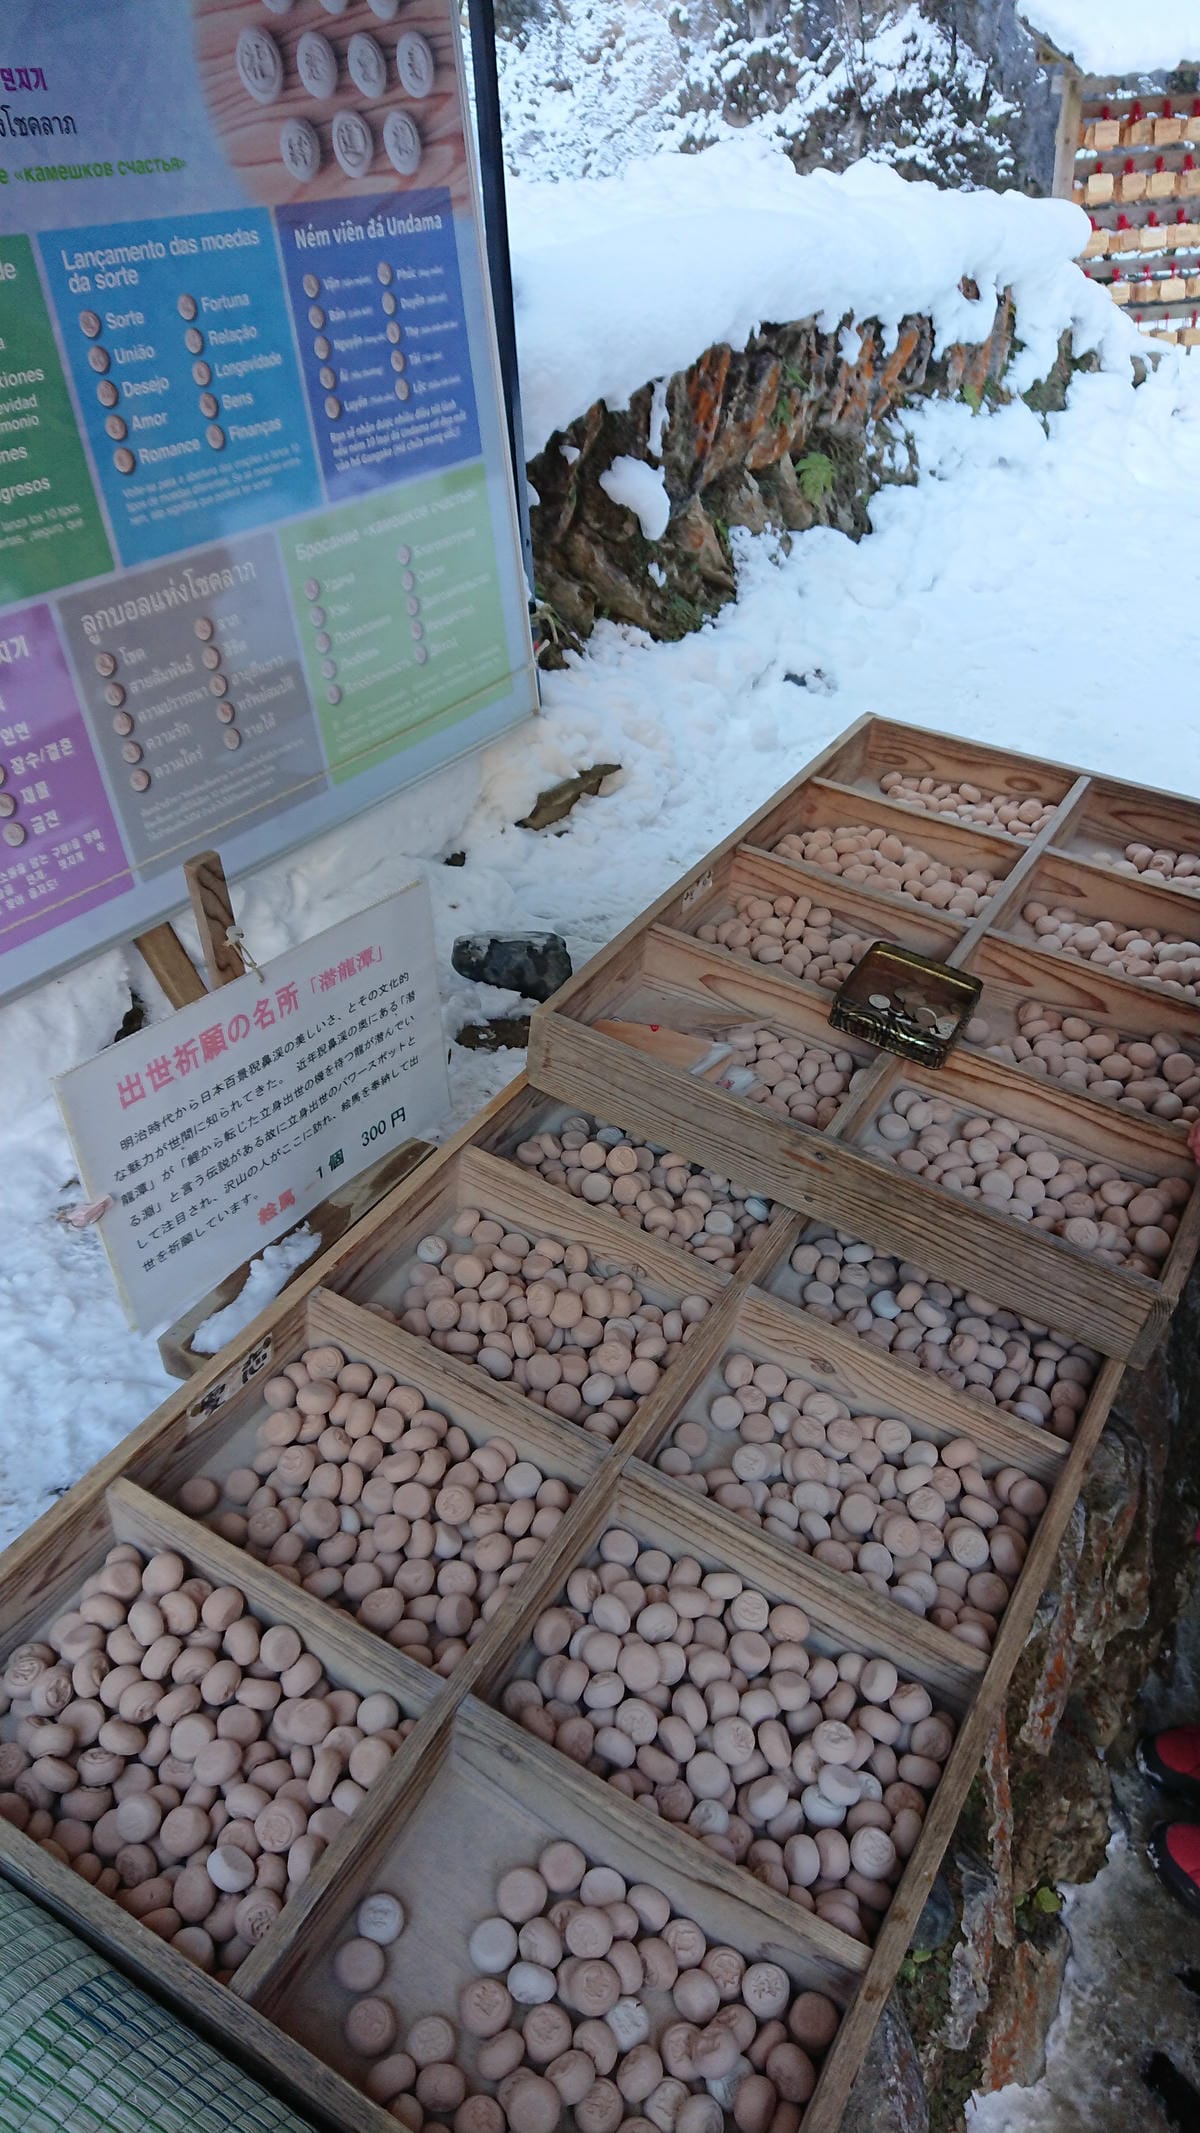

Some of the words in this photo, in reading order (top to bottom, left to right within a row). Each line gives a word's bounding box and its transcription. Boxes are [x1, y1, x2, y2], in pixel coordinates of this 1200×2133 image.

[294, 223, 331, 249] Ném
[332, 220, 364, 245] viên
[367, 215, 385, 238] đá
[387, 213, 442, 236] Undama
[61, 239, 166, 272] Lançamento
[169, 235, 198, 257] das
[201, 228, 260, 250] moedas
[68, 272, 91, 293] da
[95, 266, 139, 290] sorte
[200, 293, 250, 313] Fortuna
[105, 310, 145, 330] Sorte
[207, 325, 258, 346] Relação
[113, 344, 155, 364] União
[214, 352, 282, 378] Longevidade
[121, 376, 170, 398] Desejo
[221, 392, 254, 411] Bens
[132, 411, 169, 432] Amor
[228, 418, 283, 442] Finanças
[138, 438, 201, 465] Romance
[257, 1188, 296, 1226] 絵馬
[142, 1194, 260, 1273] 世を祈願しています。
